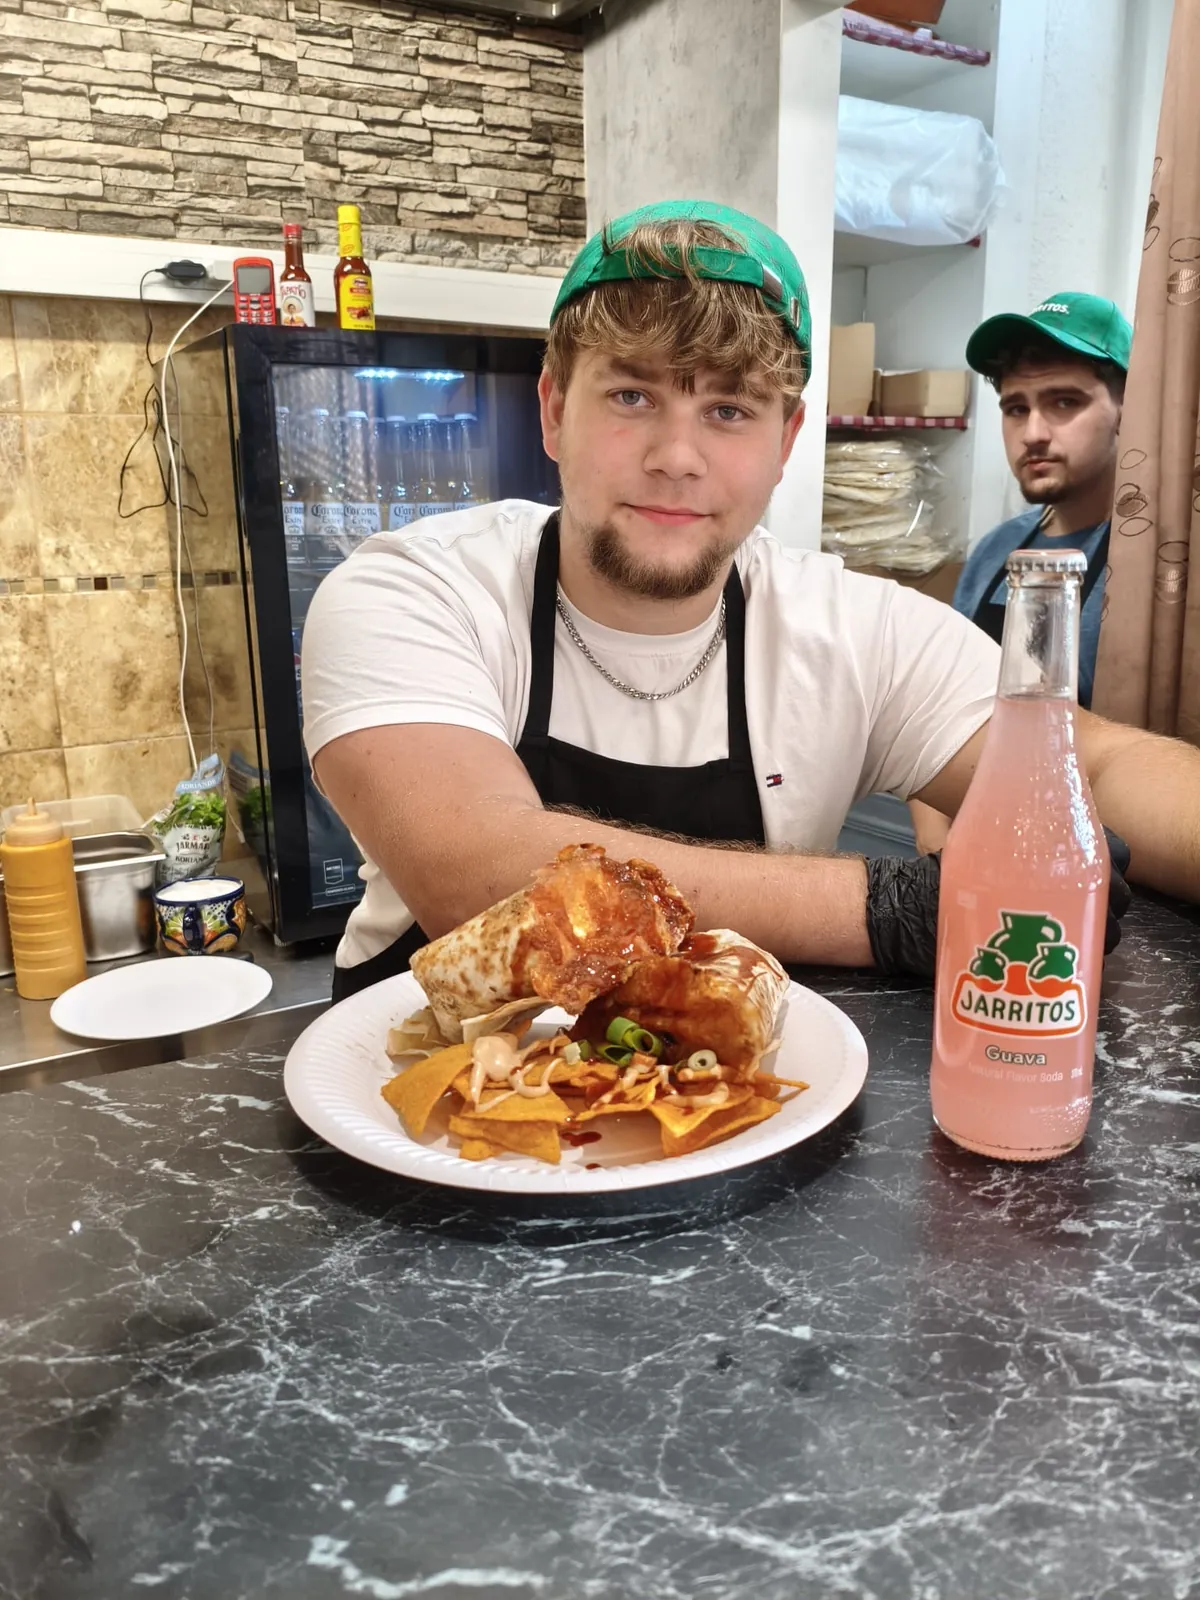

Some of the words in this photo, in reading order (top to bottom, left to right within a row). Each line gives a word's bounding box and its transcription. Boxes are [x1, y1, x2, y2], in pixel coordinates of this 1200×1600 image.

[960, 989, 1076, 1024] JARRITOS
[985, 1044, 1047, 1066] Guava
[1039, 1071, 1064, 1083] Soda
